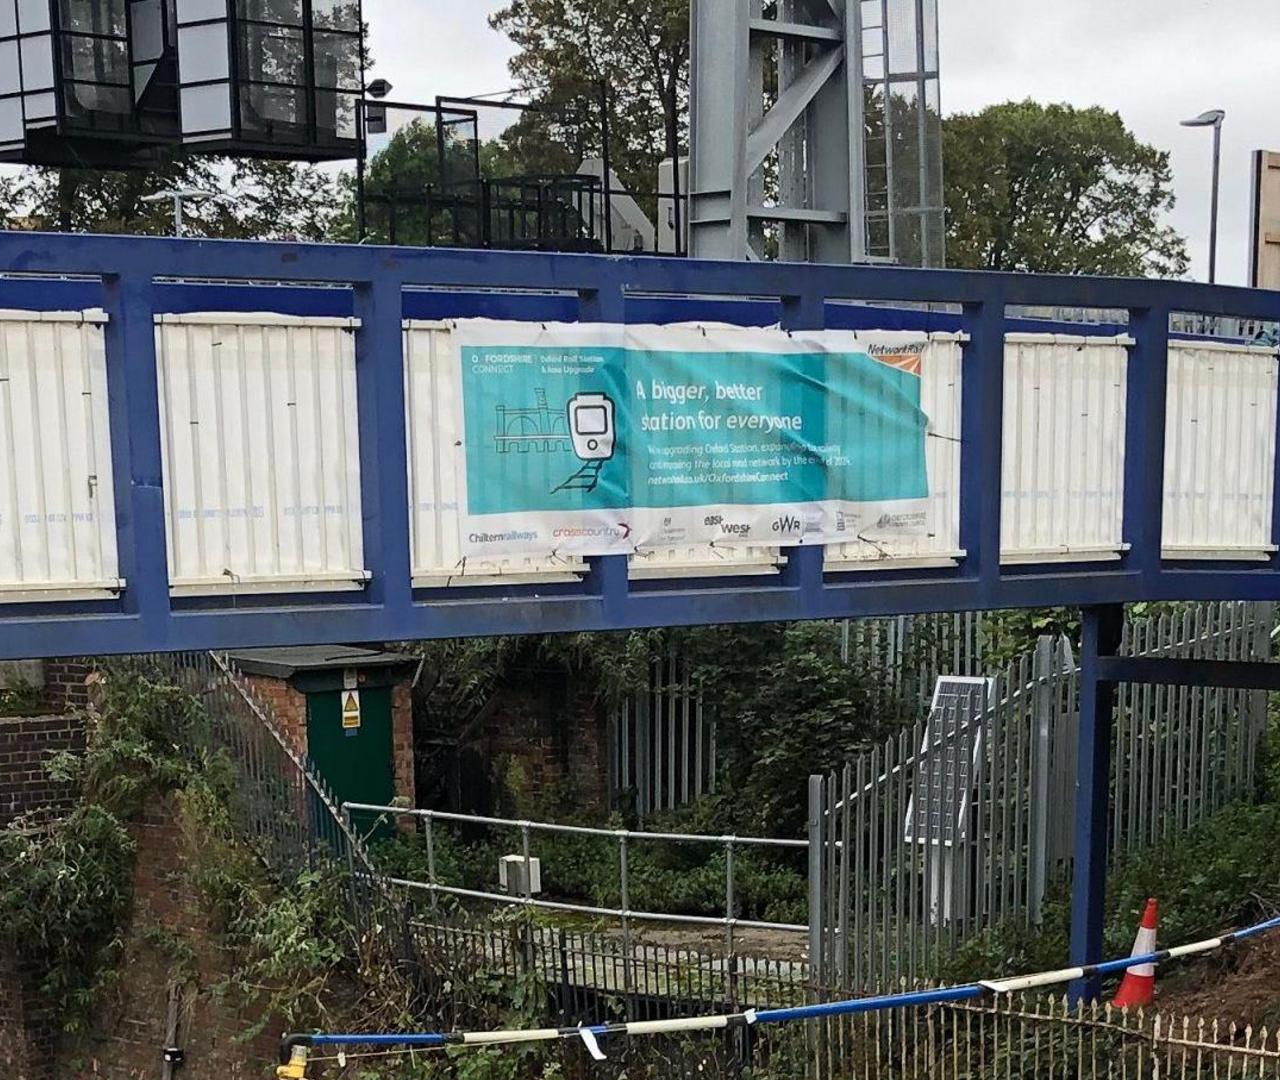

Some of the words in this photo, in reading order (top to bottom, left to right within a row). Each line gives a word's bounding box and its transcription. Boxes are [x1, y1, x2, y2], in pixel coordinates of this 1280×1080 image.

[636, 381, 646, 400] A
[652, 379, 709, 404] bigger,
[715, 381, 763, 400] better
[698, 411, 721, 430] for
[726, 414, 803, 434] everyone
[772, 514, 801, 534] GWR
